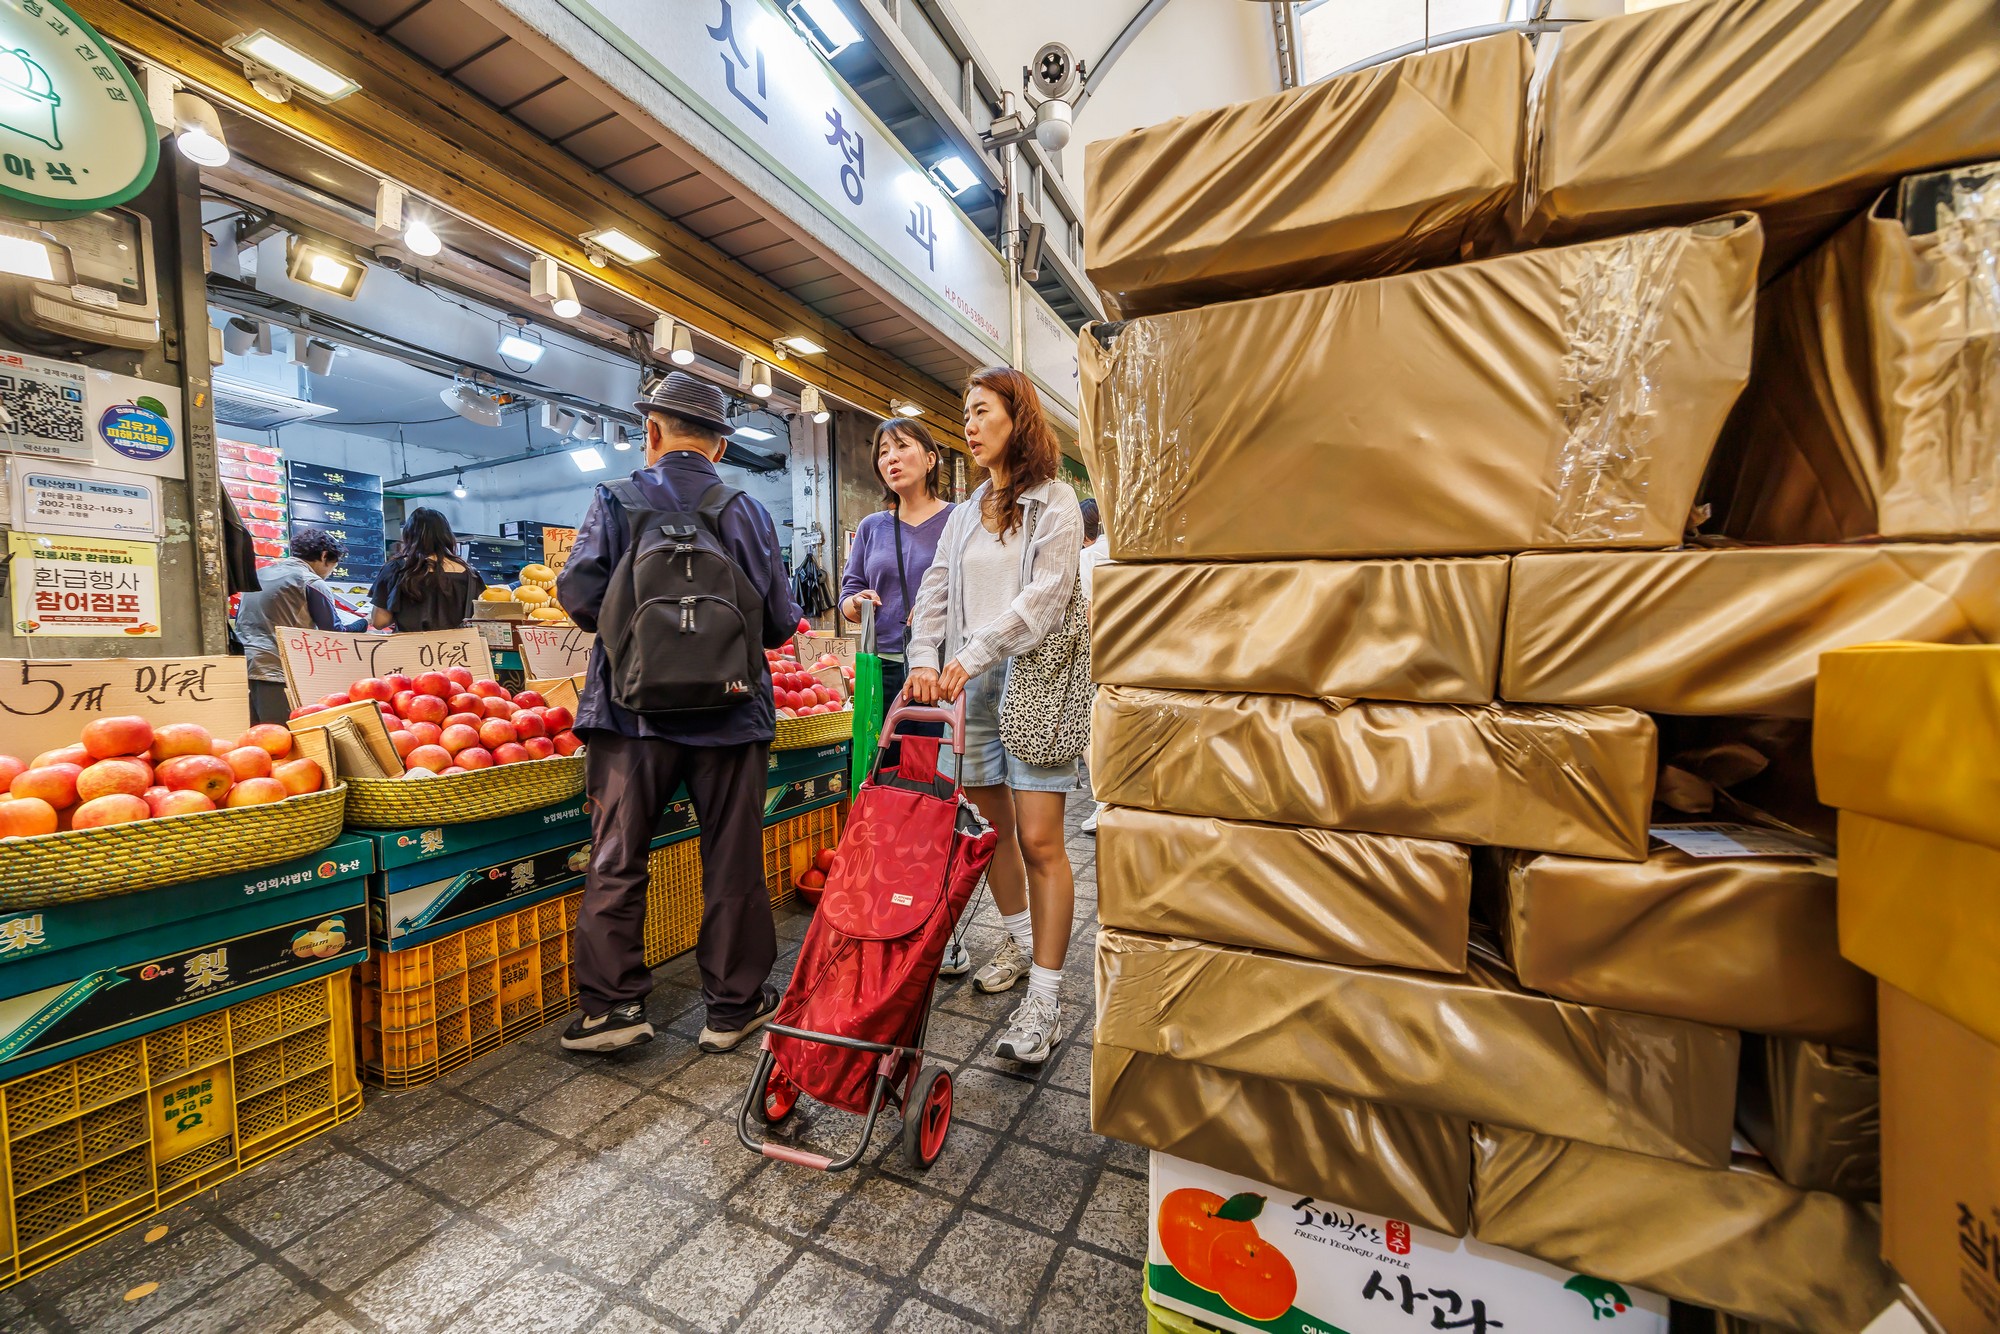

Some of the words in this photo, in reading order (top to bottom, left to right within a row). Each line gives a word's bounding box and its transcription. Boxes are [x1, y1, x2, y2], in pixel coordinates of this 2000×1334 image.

[75, 44, 128, 102] 전문점
[43, 367, 85, 381] 결제하세요
[106, 427, 169, 446] 피해지원금
[117, 418, 158, 434] 고유가
[37, 478, 76, 491] 덕신상회
[38, 499, 134, 515] 9002-1832-1439-3
[33, 550, 82, 562] 전통시장
[85, 553, 133, 565] 환급행사
[33, 567, 140, 592] 환급행사
[35, 591, 140, 613] 참여점포
[291, 631, 348, 676] 아리수
[524, 627, 558, 655] 아리수
[135, 664, 217, 704] 만원
[725, 680, 748, 693] JAL
[543, 807, 580, 824] 농업회사법인
[244, 870, 313, 895] 농업회사법인
[339, 859, 360, 873] 농산
[511, 860, 536, 891] 梨
[280, 939, 329, 957] Premium
[325, 940, 352, 952] Pears
[184, 948, 230, 992] 梨
[6, 1024, 38, 1050] QUALITY
[38, 1005, 62, 1026] FRESH
[60, 989, 82, 1008] GOOD
[80, 975, 104, 993] FRUIT
[1291, 1196, 1384, 1246] 소백산
[1294, 1228, 1327, 1244] FRESH
[1329, 1238, 1374, 1259] YEONGJU
[1375, 1252, 1411, 1270] APPLE
[1388, 1220, 1407, 1253] 영주
[1361, 1269, 1504, 1334] 사과
